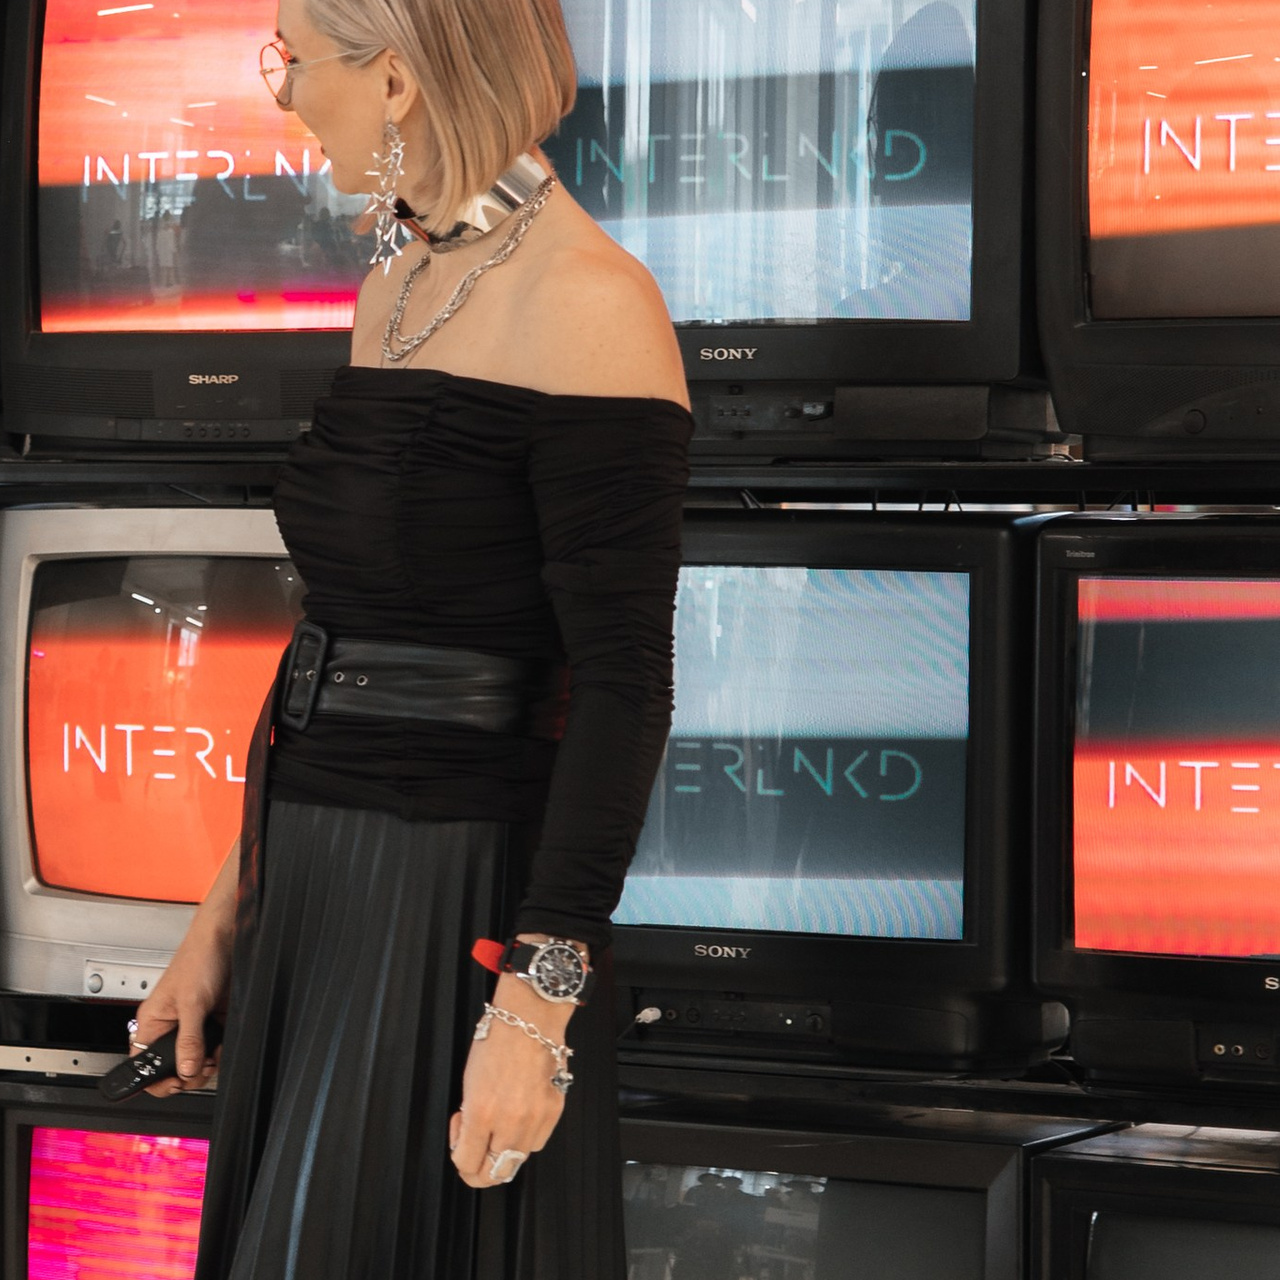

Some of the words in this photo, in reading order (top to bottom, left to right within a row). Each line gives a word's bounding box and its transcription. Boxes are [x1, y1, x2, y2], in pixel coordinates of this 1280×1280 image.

[699, 347, 757, 360] SONY
[189, 375, 239, 384] SHARP
[1107, 761, 1280, 814] INTE
[694, 944, 752, 959] SONY
